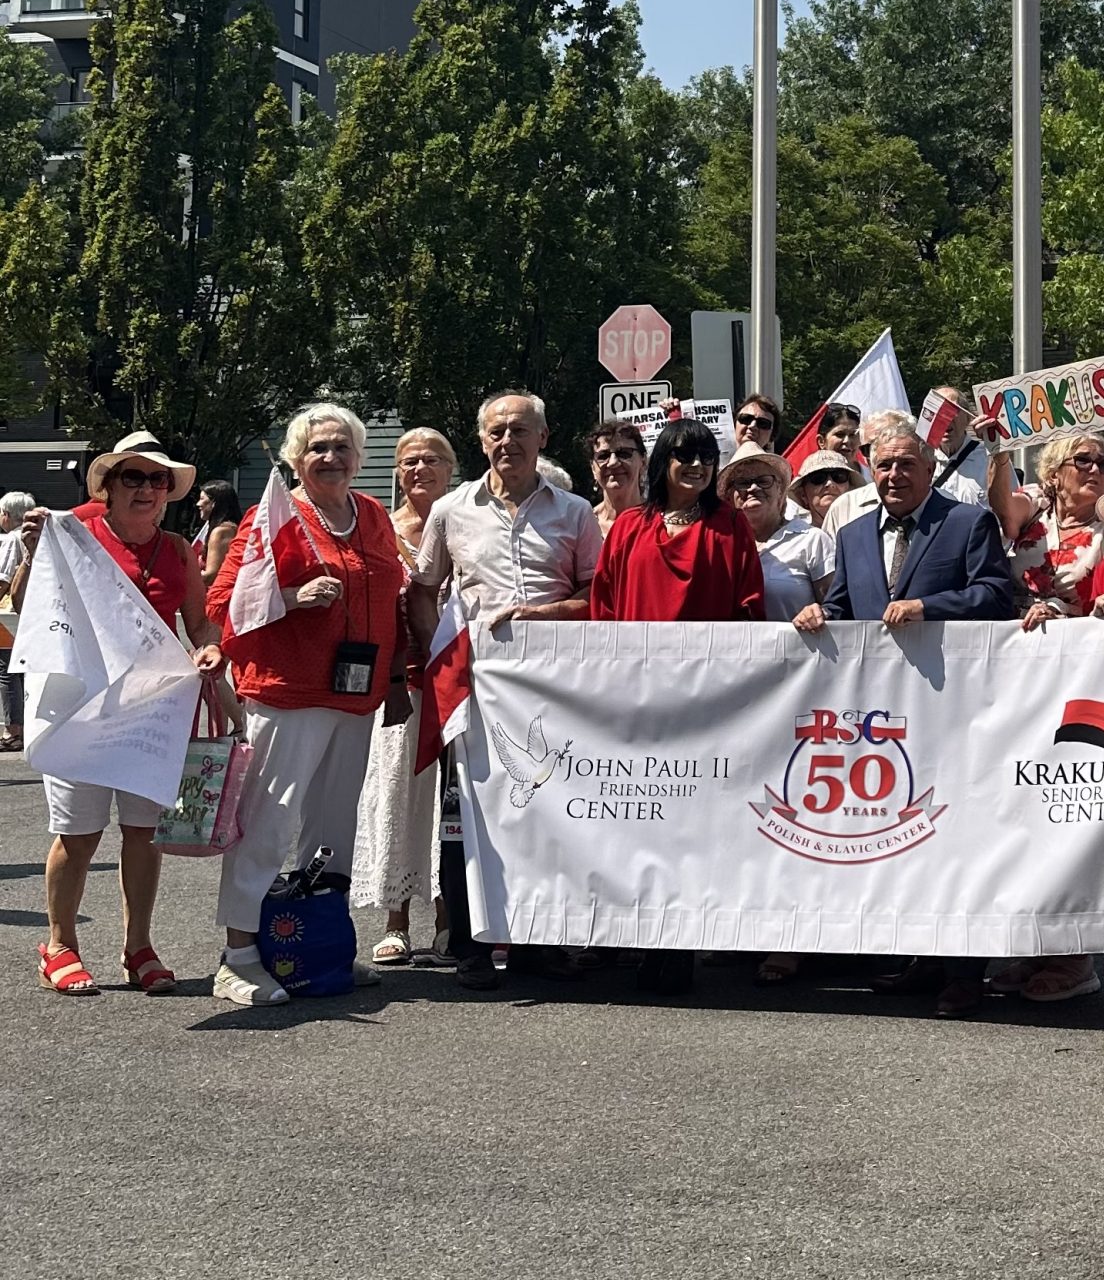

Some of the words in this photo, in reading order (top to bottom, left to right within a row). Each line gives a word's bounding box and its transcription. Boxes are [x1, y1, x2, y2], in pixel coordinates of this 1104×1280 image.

[604, 329, 666, 359] STOP
[810, 709, 889, 745] PSC
[564, 755, 633, 782] JOHN
[644, 756, 703, 778] PAUL
[712, 757, 730, 778] II
[599, 781, 697, 797] FRIENDSHIP
[802, 754, 897, 814] 50
[1042, 786, 1103, 803] SENIOR
[566, 798, 666, 820] CENTER
[842, 806, 888, 817] YEARS
[445, 825, 463, 835] 194
[766, 819, 812, 851] POLISH
[813, 842, 823, 851] &
[827, 843, 873, 854] SLAVIC
[877, 821, 928, 850] CENTER
